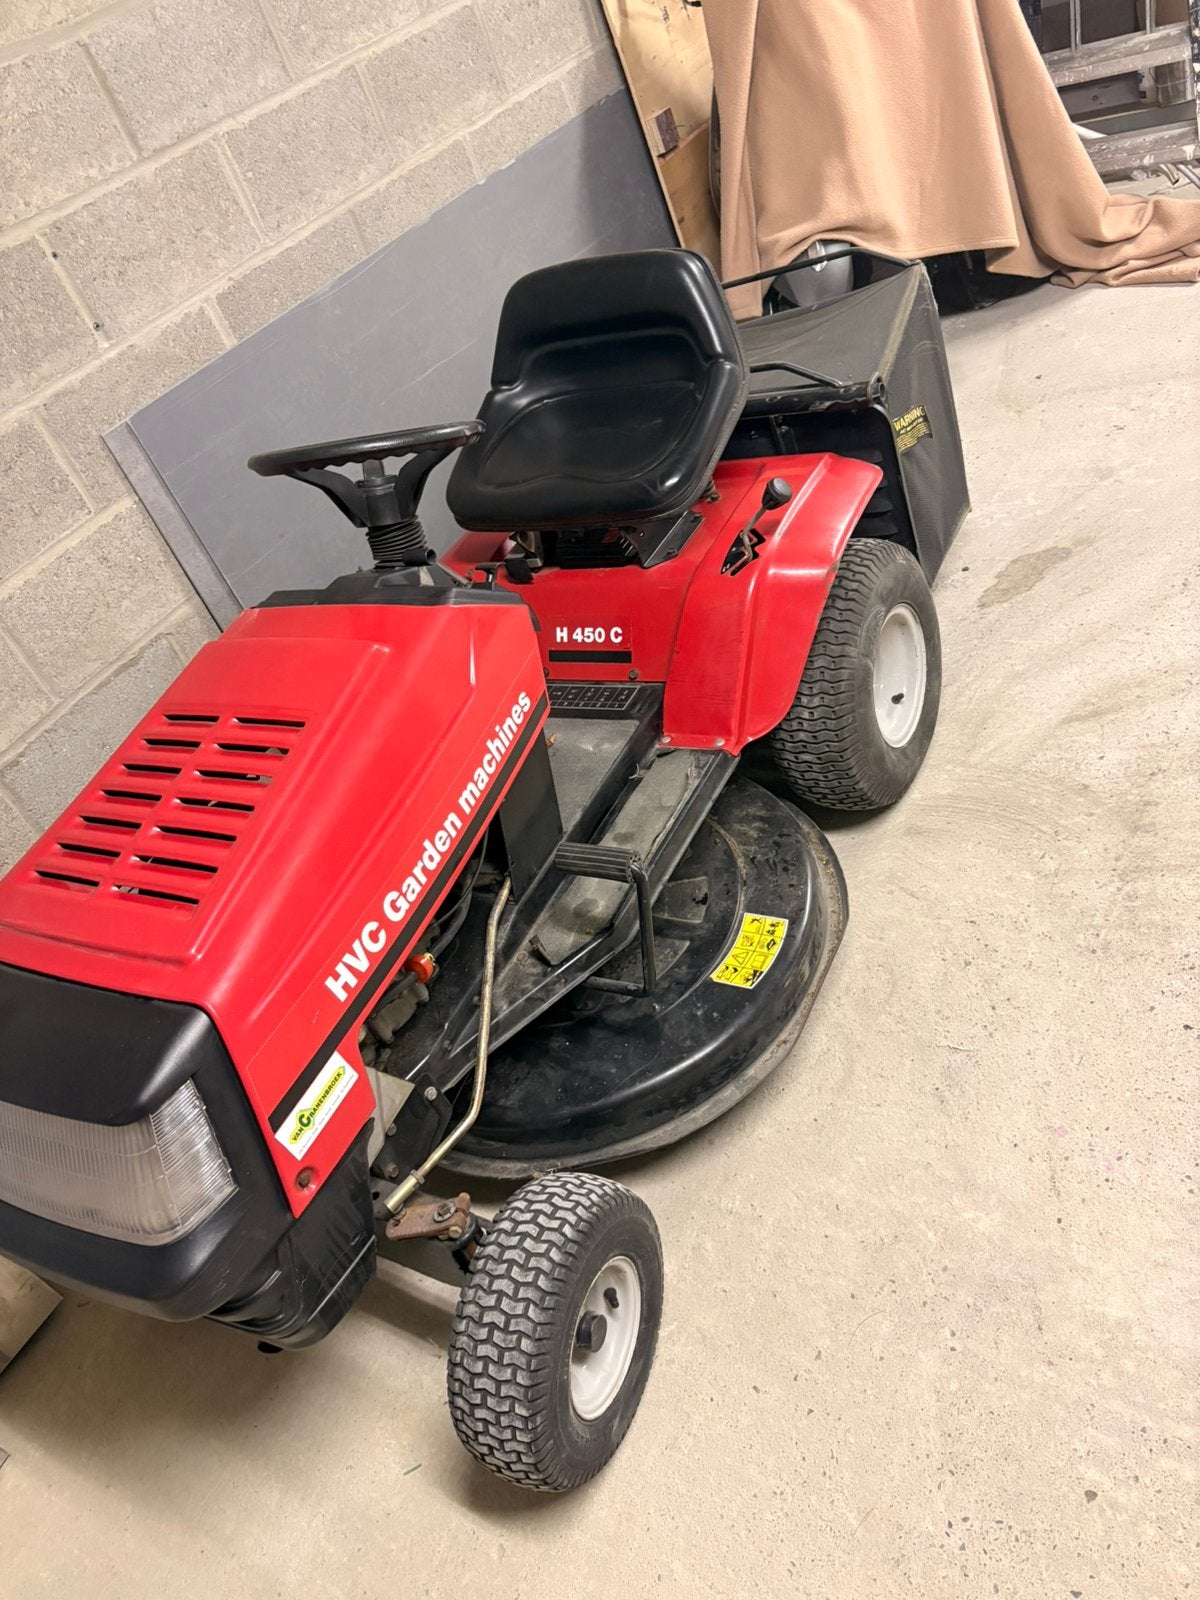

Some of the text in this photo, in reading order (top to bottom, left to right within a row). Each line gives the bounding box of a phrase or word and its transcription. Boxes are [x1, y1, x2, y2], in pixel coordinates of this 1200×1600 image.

[893, 406, 926, 431] WARNING
[556, 626, 623, 643] H 450 C
[324, 921, 387, 1002] HVC
[382, 812, 463, 923] Garden
[458, 691, 531, 815] machines
